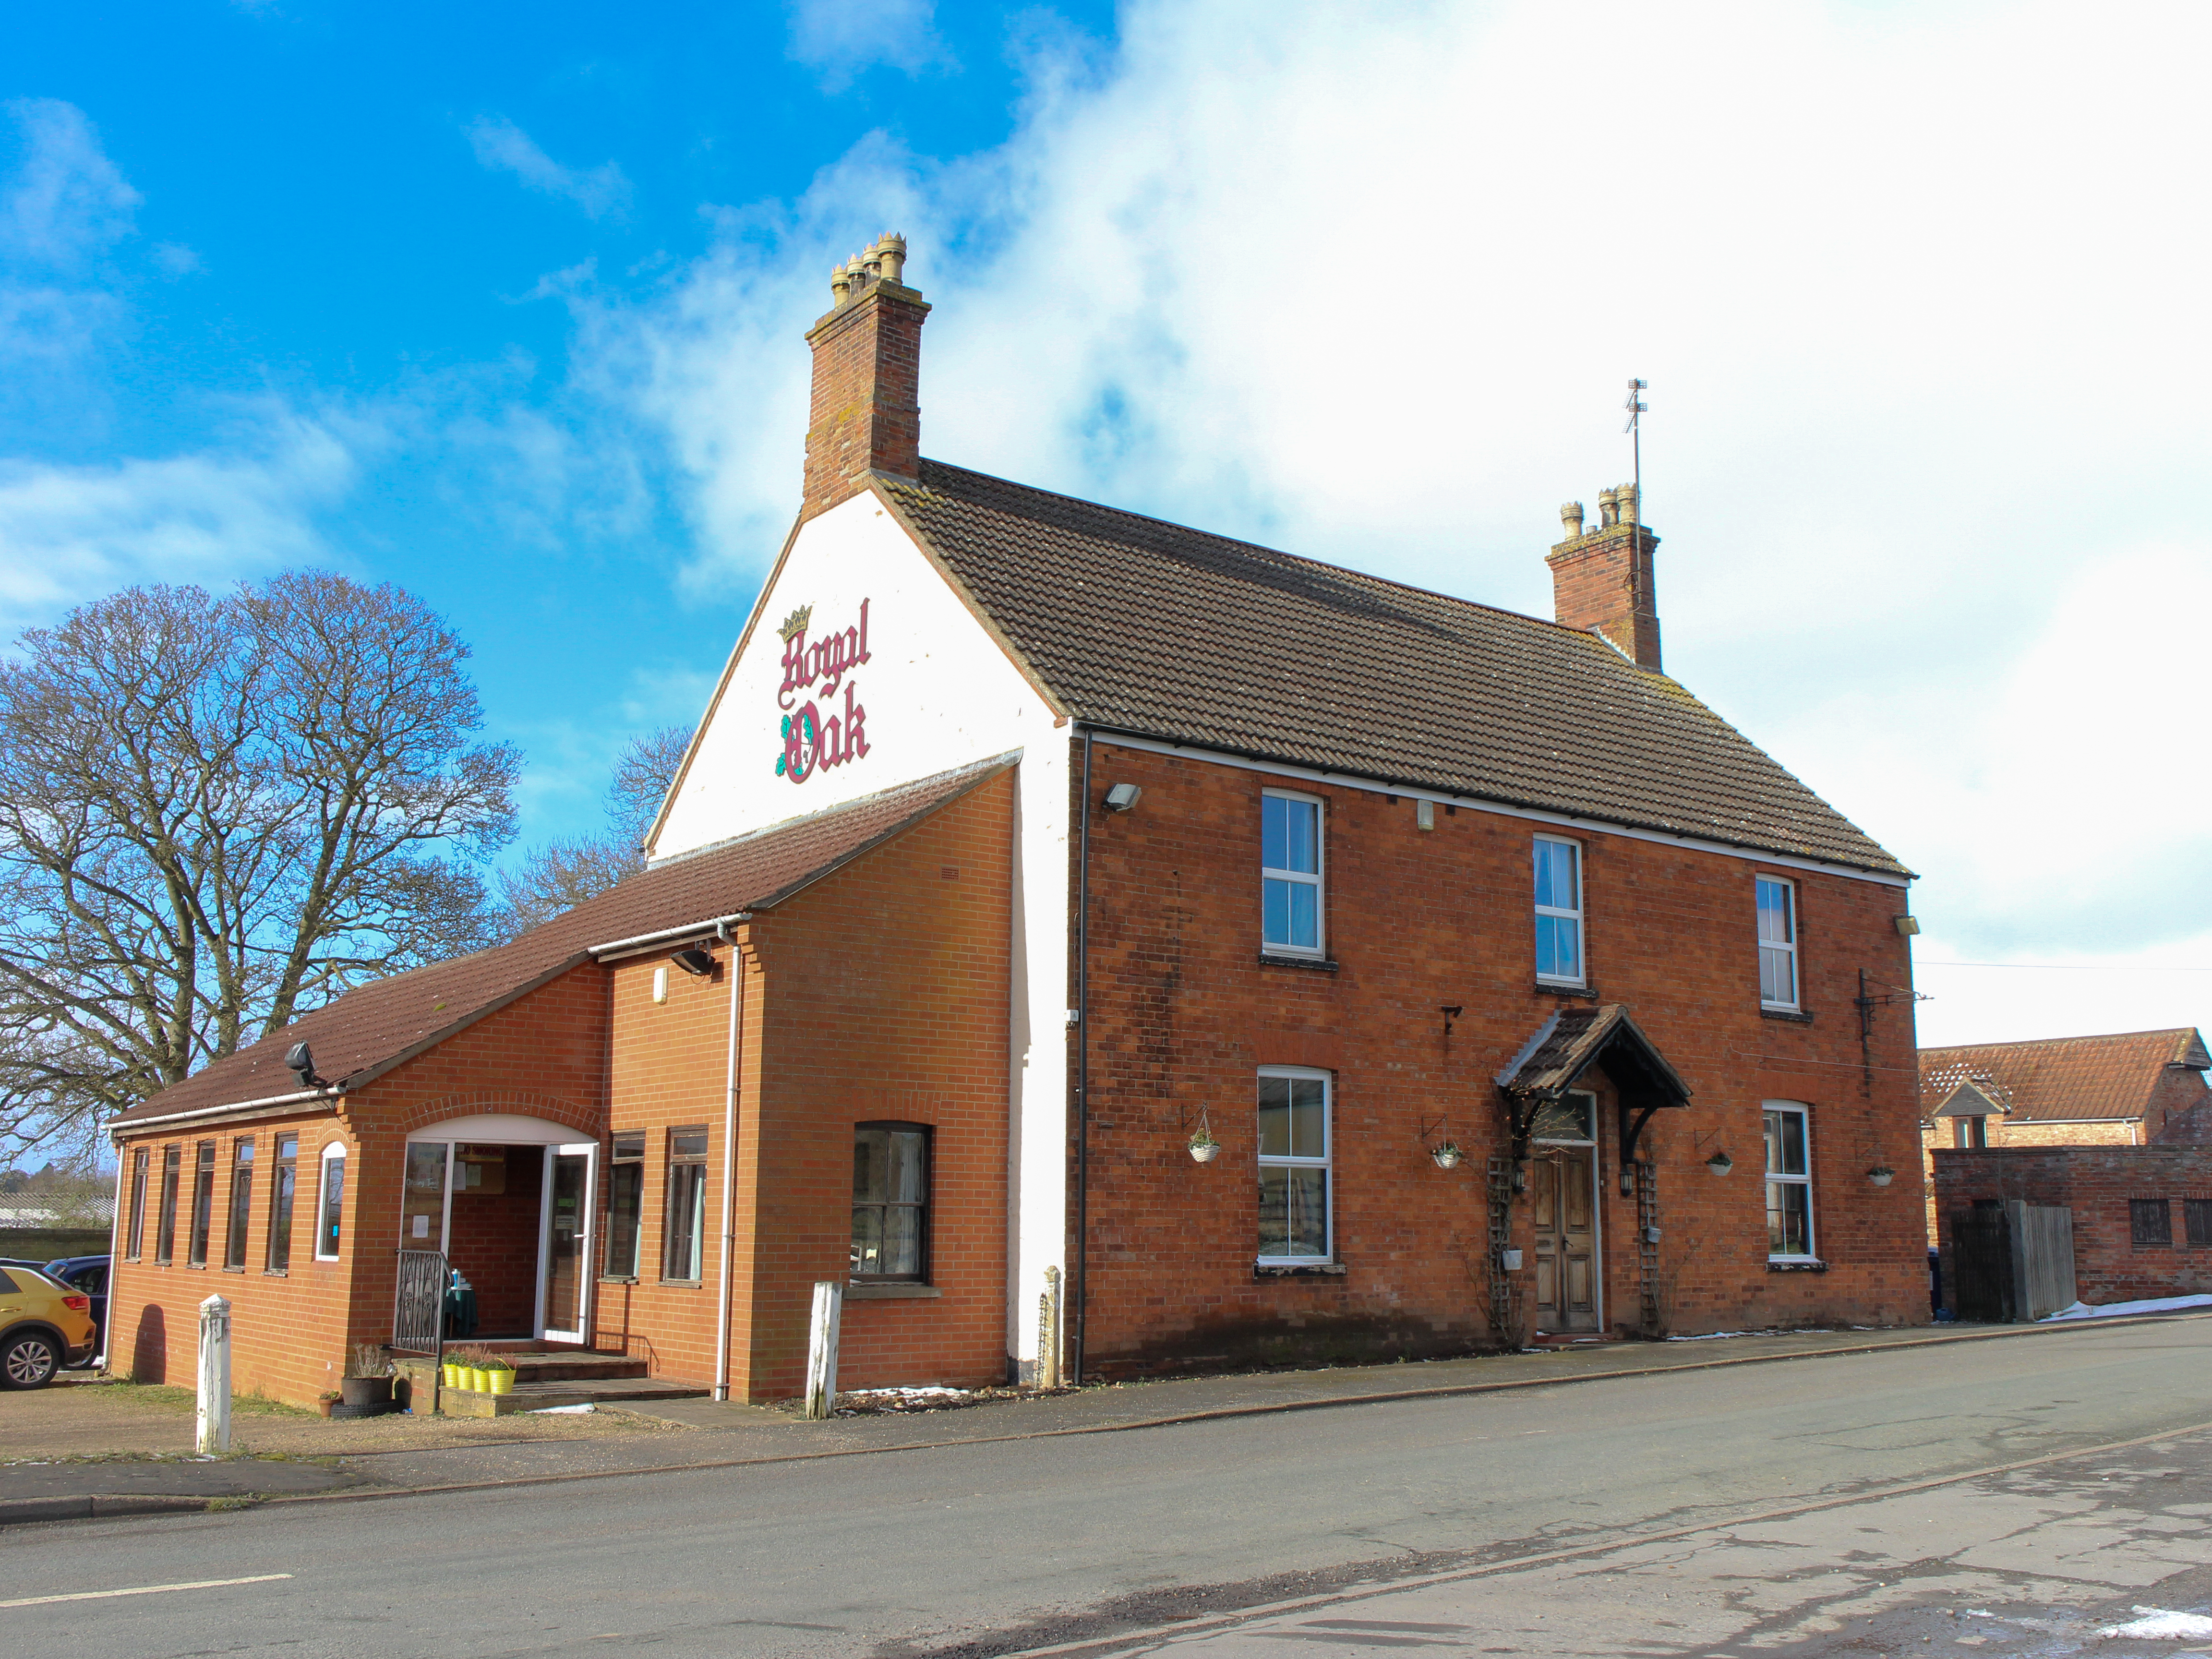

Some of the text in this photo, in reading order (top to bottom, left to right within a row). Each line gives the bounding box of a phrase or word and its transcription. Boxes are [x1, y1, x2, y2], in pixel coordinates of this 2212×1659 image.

[778, 597, 871, 710] Royal
[785, 680, 871, 784] Oak
[472, 1145, 504, 1156] SMOKING
